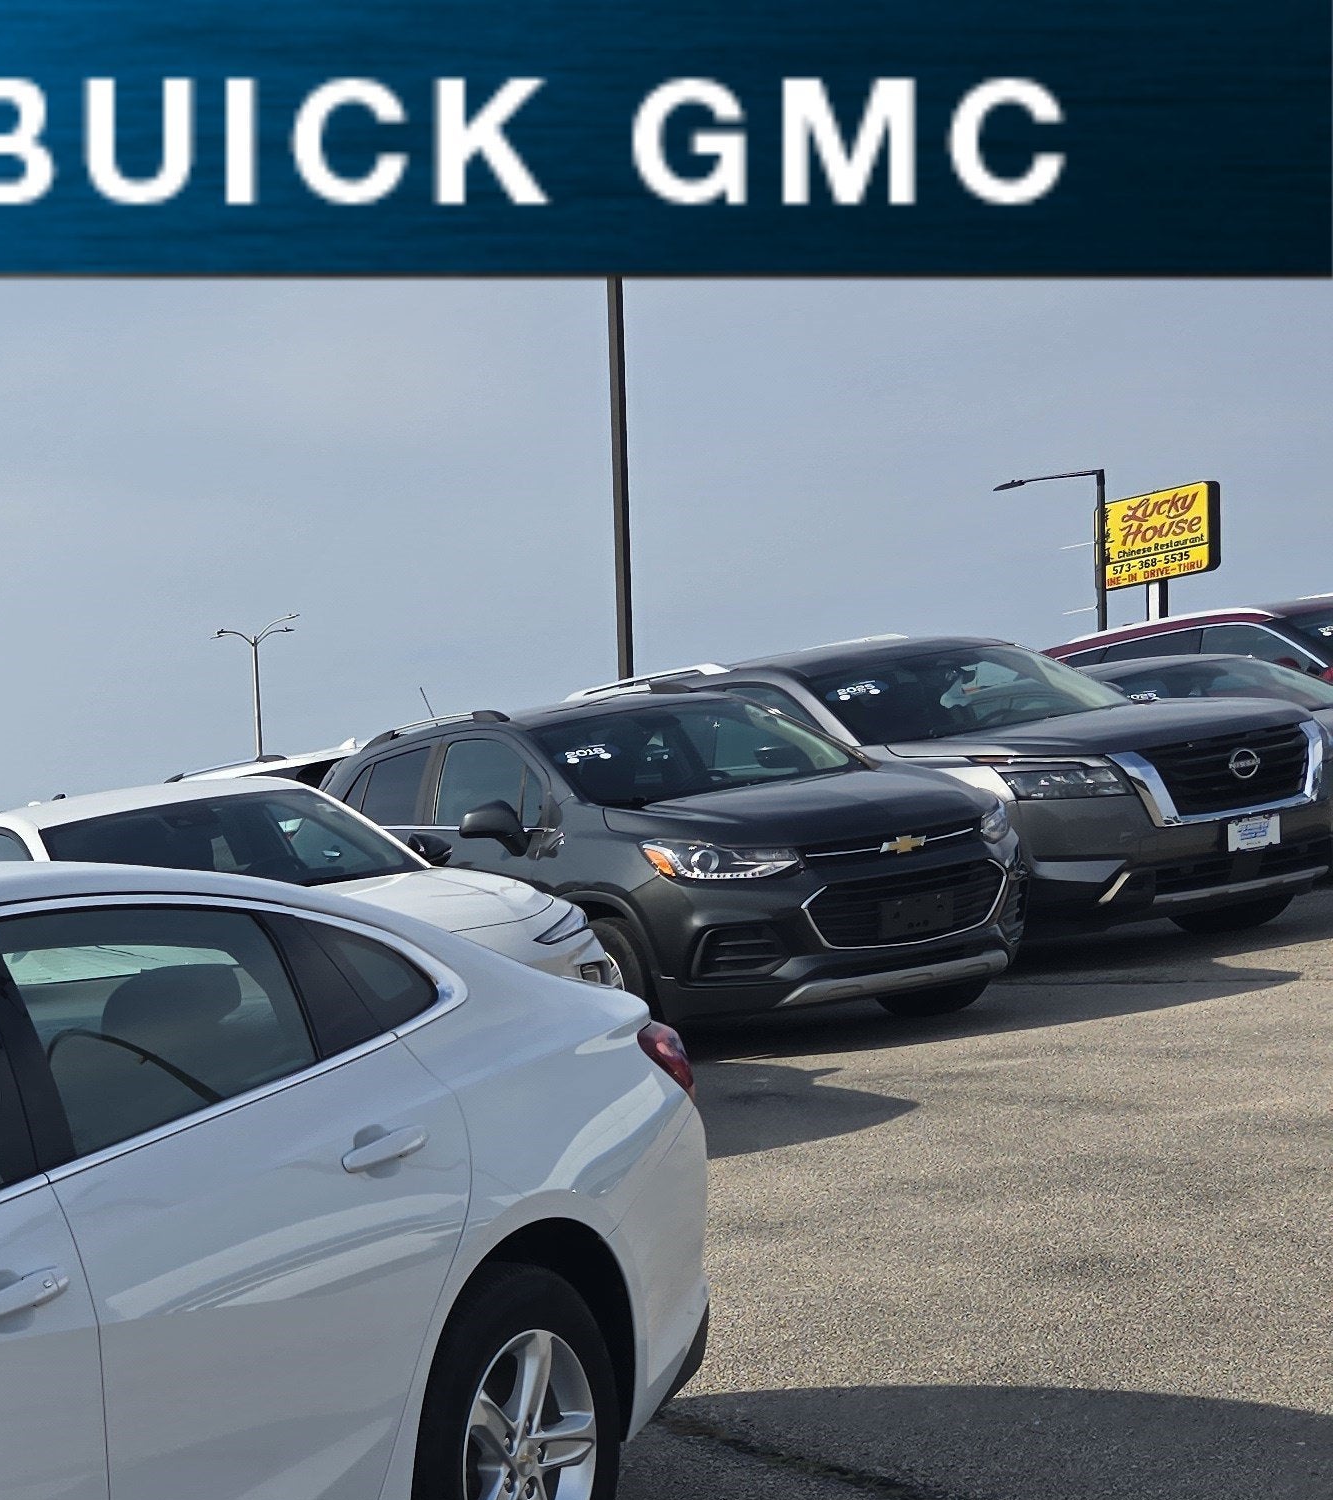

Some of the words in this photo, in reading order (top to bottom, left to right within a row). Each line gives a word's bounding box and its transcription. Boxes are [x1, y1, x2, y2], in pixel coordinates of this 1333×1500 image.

[1121, 490, 1200, 522] Lucky
[1119, 516, 1202, 546] House
[1118, 545, 1152, 559] Chinese
[1154, 534, 1204, 551] Restaurant
[1107, 573, 1137, 587] INE-IN
[1144, 559, 1203, 579] DRIVE-THRU
[565, 747, 605, 759] 2018
